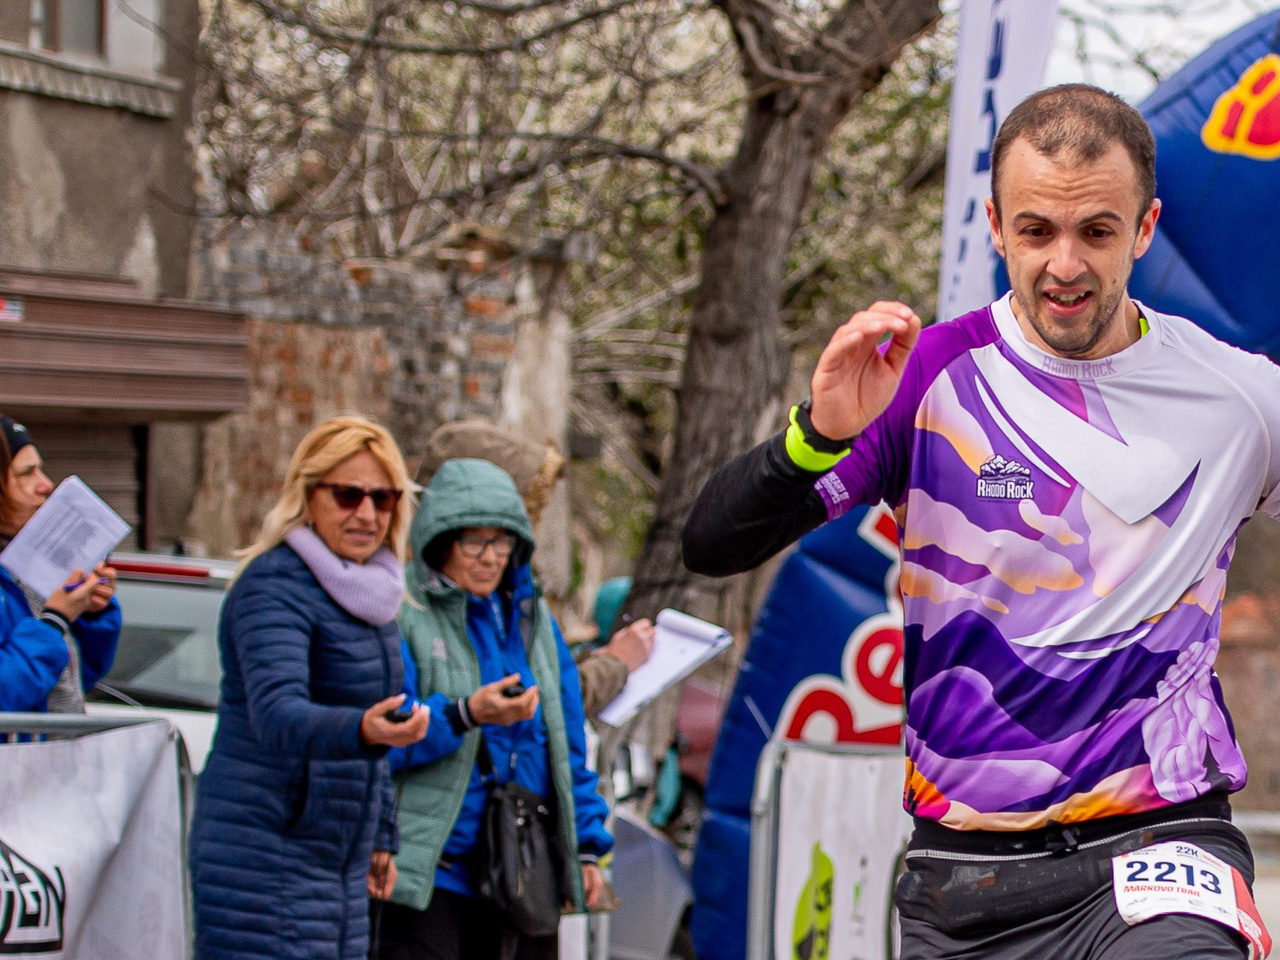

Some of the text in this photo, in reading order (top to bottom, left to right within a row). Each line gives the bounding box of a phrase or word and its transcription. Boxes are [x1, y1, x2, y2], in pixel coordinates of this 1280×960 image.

[1007, 481, 1034, 499] ROCK
[1175, 845, 1199, 858] 22K
[1126, 861, 1222, 895] 2213
[1123, 884, 1201, 897] MARKOVO TRAIL
